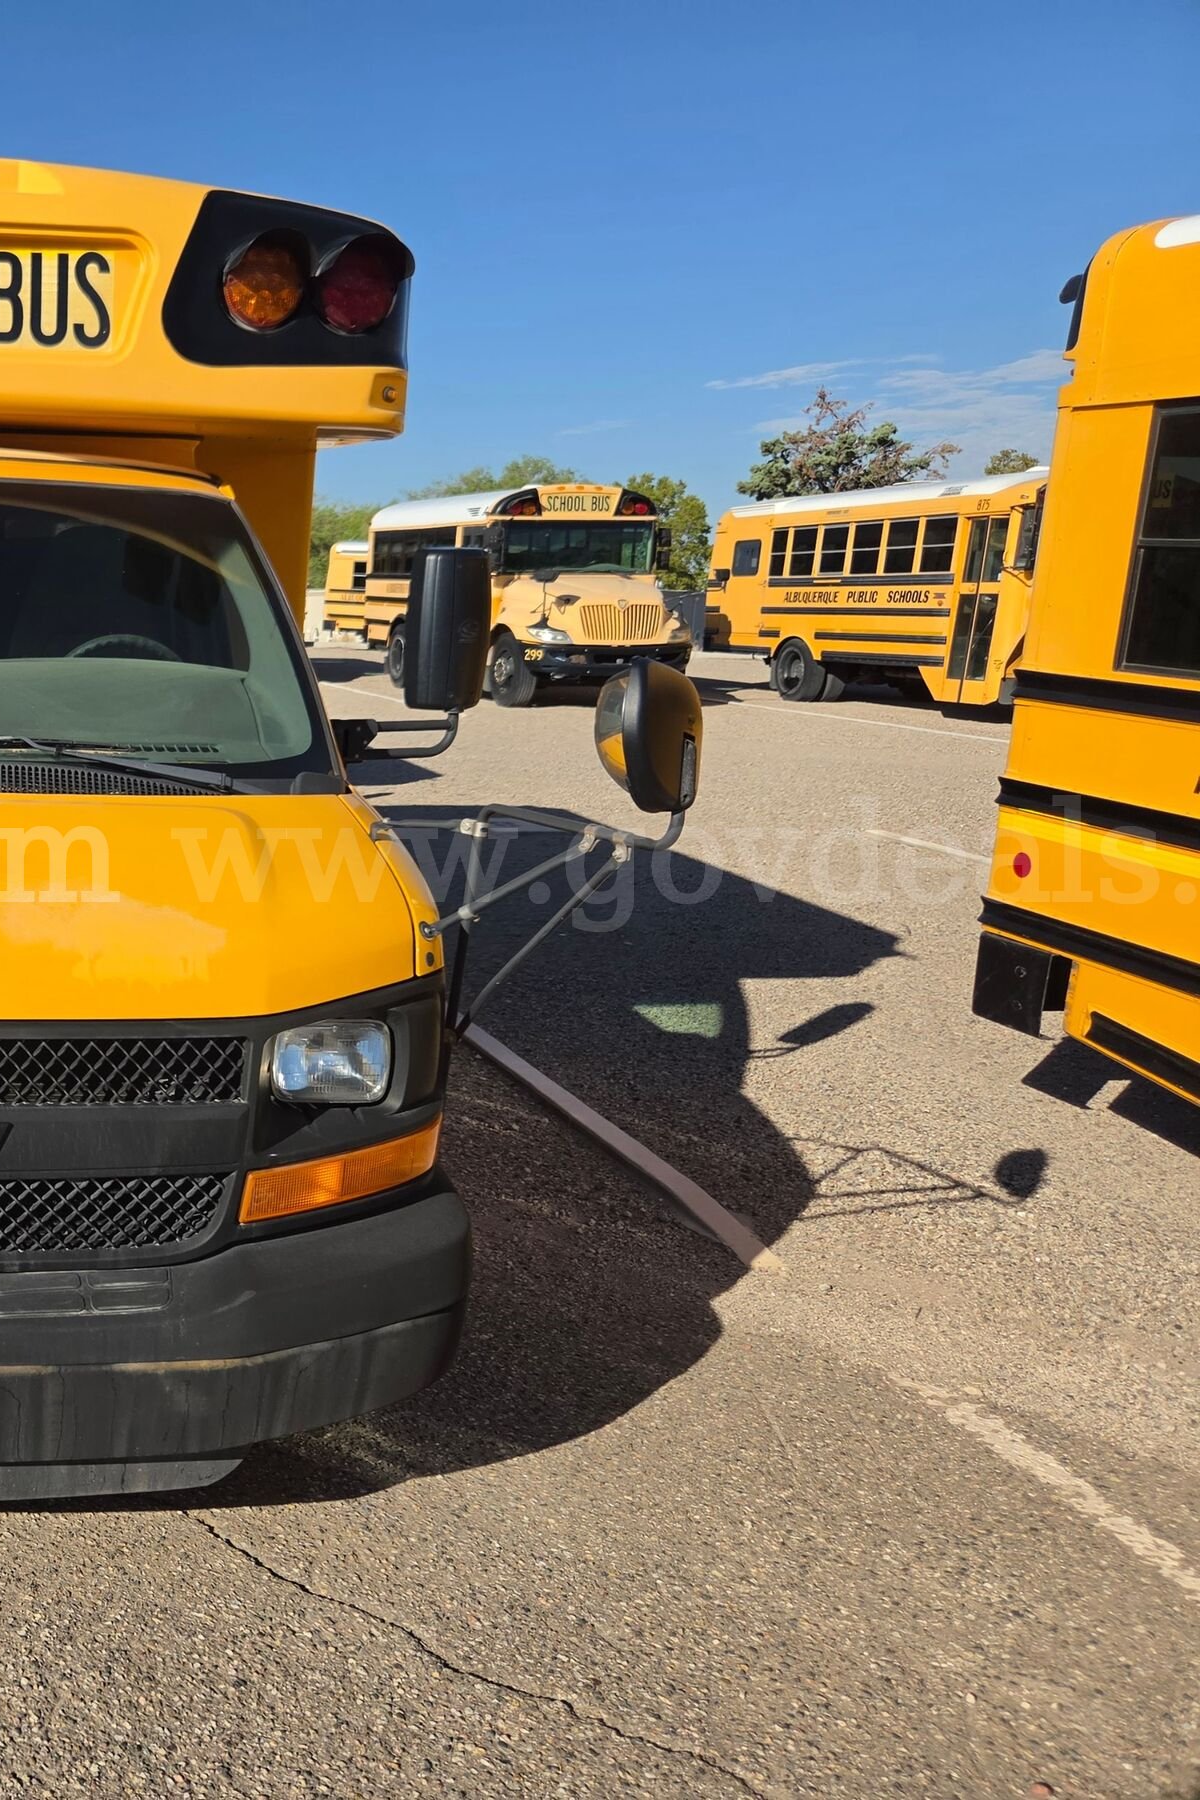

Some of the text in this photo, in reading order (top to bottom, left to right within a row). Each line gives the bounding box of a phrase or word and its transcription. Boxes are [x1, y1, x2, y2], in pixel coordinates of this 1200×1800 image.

[547, 496, 611, 512] SCHOOL BUS
[976, 498, 991, 511] 875
[784, 590, 930, 604] ALBUQUERQUE PUBLIC SCHOOLS
[524, 649, 544, 661] 299
